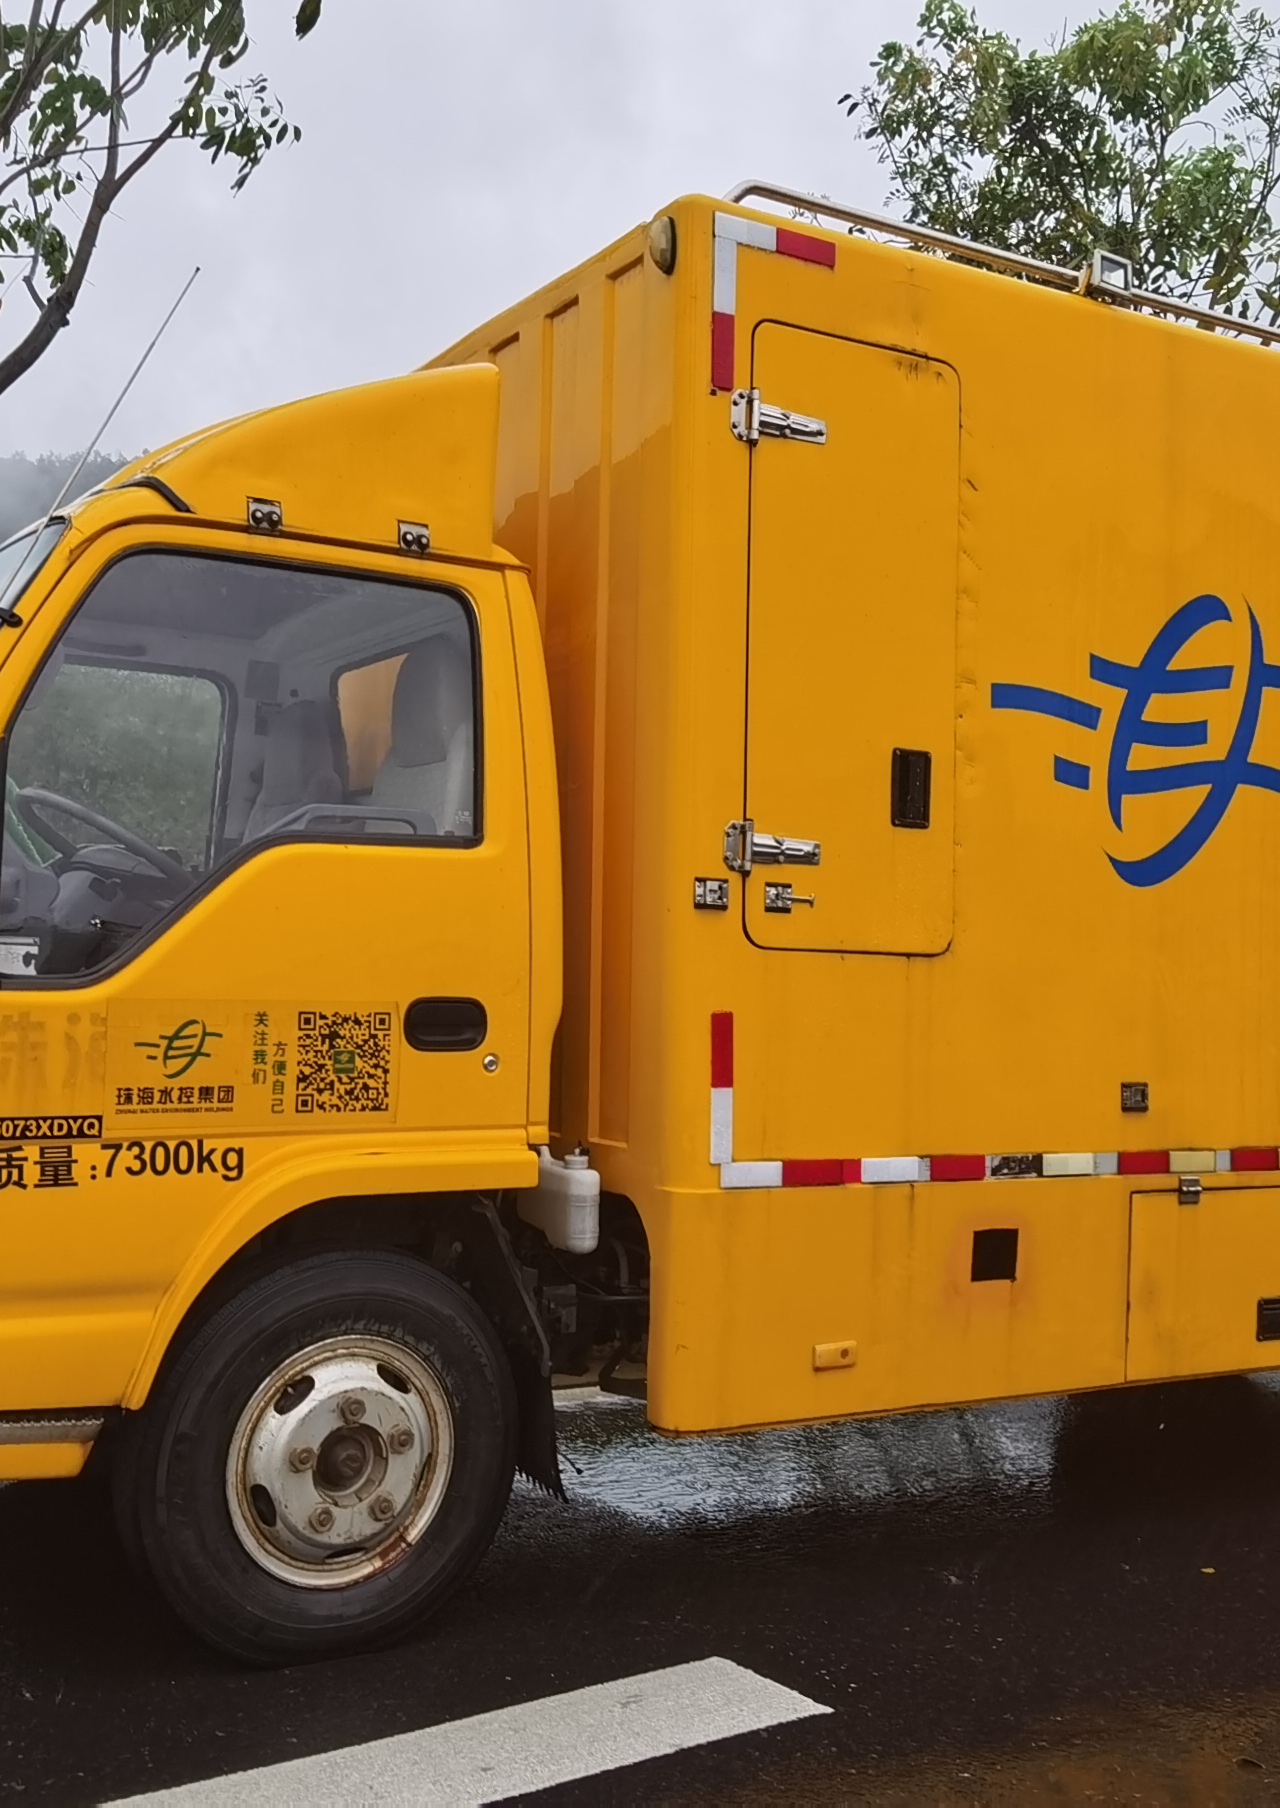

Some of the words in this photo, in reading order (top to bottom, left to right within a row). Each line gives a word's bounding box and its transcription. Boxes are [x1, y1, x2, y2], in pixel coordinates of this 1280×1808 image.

[251, 1010, 270, 1086] 关注我们
[270, 1040, 288, 1115] 方便自己
[115, 1085, 235, 1106] 珠海水控集团
